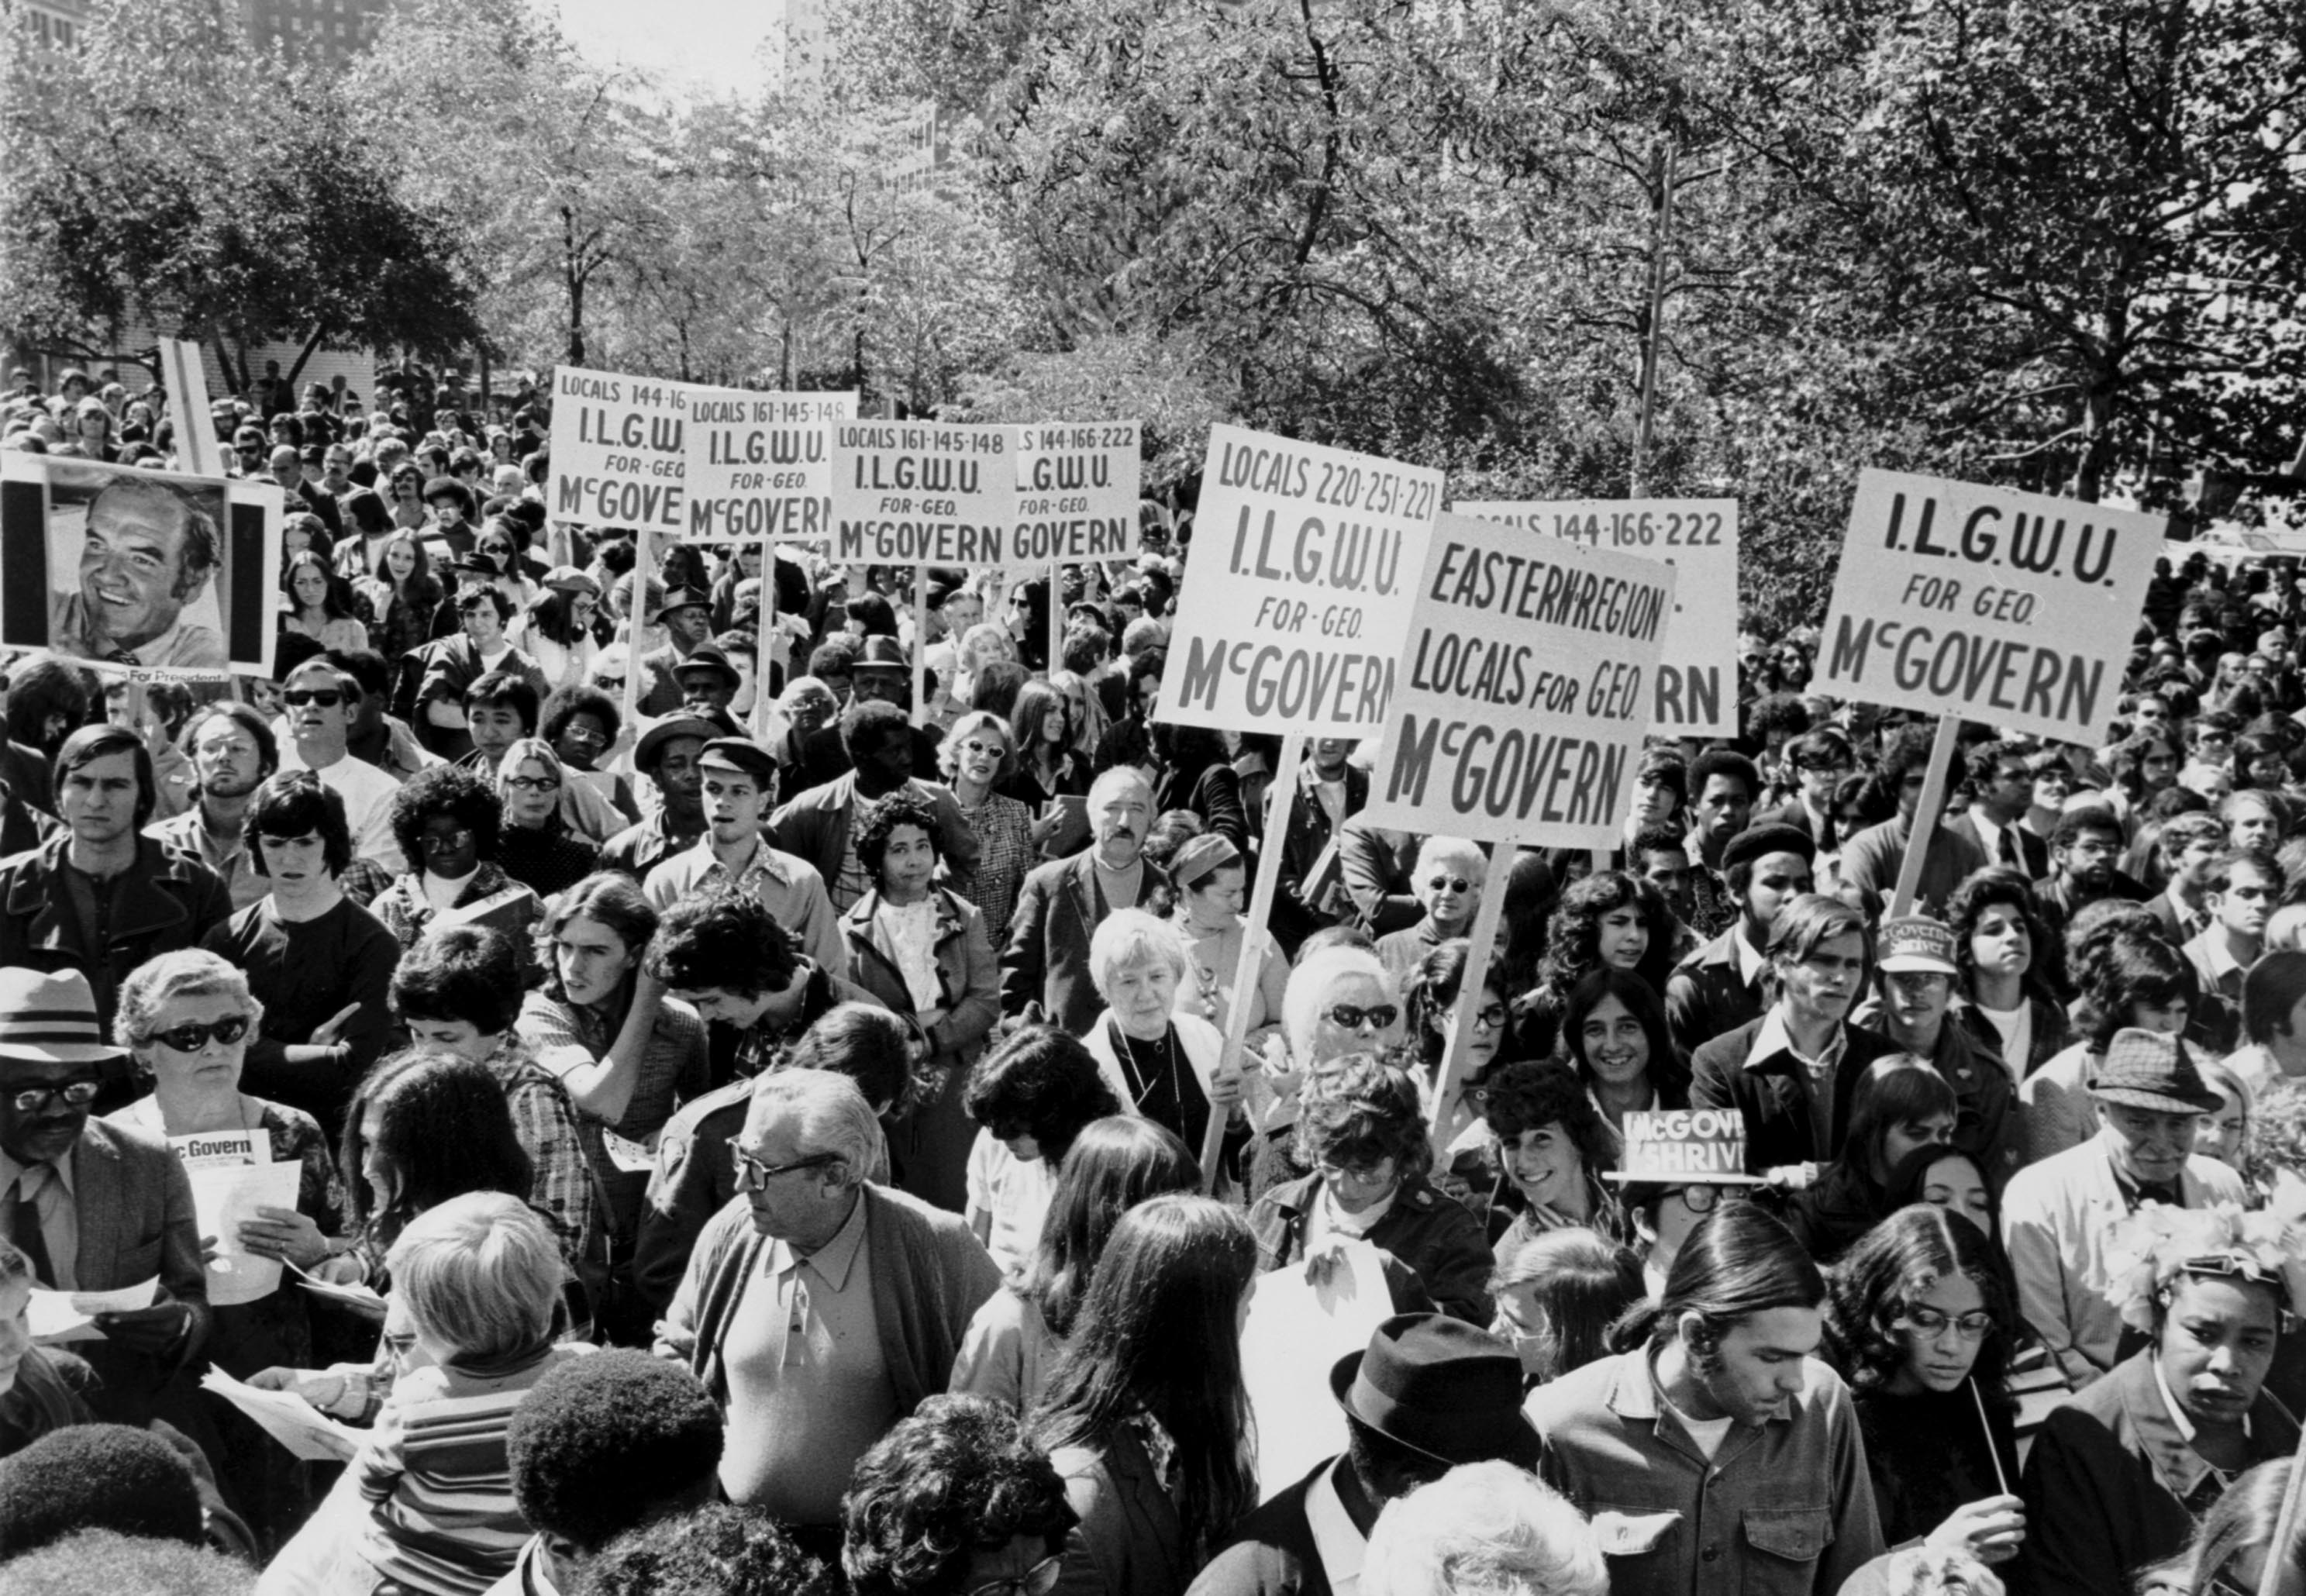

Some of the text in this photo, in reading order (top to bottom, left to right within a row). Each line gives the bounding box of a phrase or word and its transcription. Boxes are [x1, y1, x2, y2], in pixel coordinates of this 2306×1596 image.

[561, 375, 686, 409] LOCALS 144-16
[693, 402, 844, 423] LOCALS 161-145-148
[579, 407, 685, 454] I.L.G.W.
[709, 429, 826, 465] I.L.G.W.U.
[839, 427, 895, 450] LOCALS
[901, 429, 1003, 454] 161-145-148
[1040, 427, 1133, 450] 144-166-222
[604, 455, 685, 478] FOR-GEO
[856, 455, 982, 494] I.L.G.W.U.
[1219, 442, 1436, 521] LOCALS 220-251-221
[558, 474, 684, 526] McGOVE
[839, 520, 1002, 563] McGOVERN
[1012, 517, 1126, 559] GOVERN
[1553, 512, 1722, 546] 144-166-222
[1884, 493, 2117, 588] I.L.G.W.U.
[1229, 505, 1401, 596] I.L.G.W.U.
[1902, 574, 2035, 626] FOR GEO.
[130, 670, 151, 682] For
[155, 670, 222, 682] President
[1411, 628, 1532, 705] LOCALS
[1529, 671, 1579, 714] FOR
[1586, 660, 1640, 720] GEO.
[1829, 615, 2104, 726] McGOVERN
[1386, 713, 1627, 826] McGOVERN
